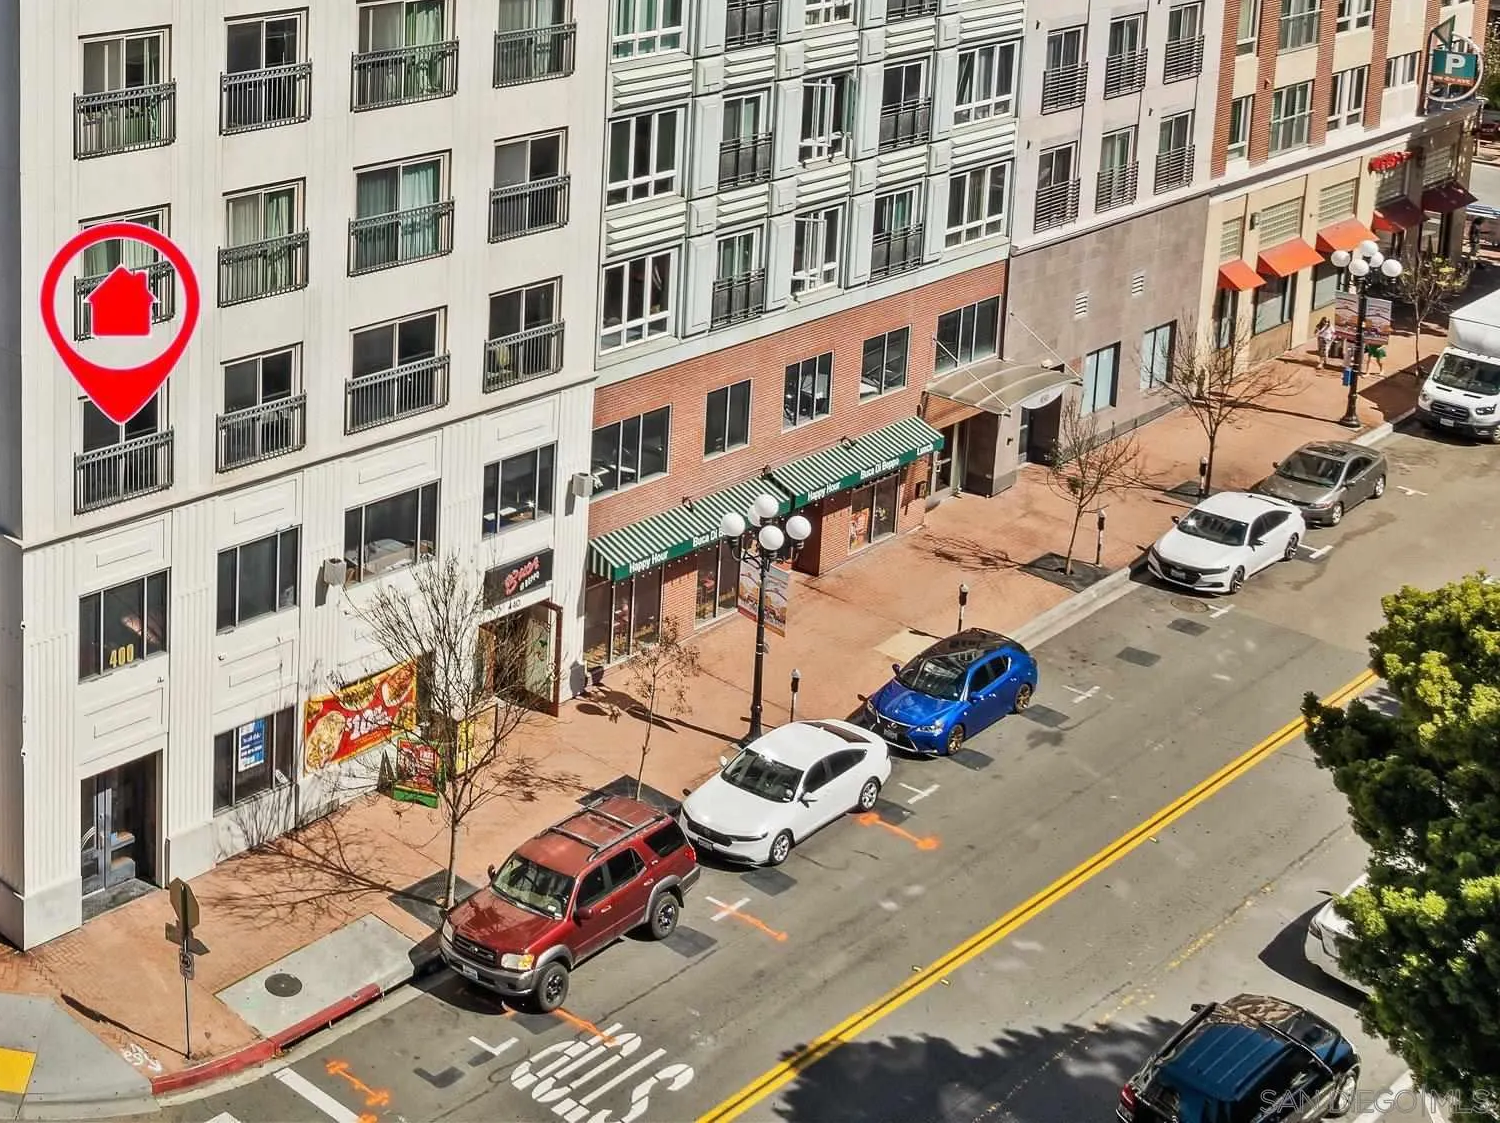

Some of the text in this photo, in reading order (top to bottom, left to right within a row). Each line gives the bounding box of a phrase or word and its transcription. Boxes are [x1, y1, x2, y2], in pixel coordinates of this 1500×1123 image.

[1445, 53, 1466, 75] P
[807, 480, 841, 501] Happy Hour
[629, 557, 652, 574] Happy
[652, 550, 669, 565] Hour
[109, 643, 134, 668] 400
